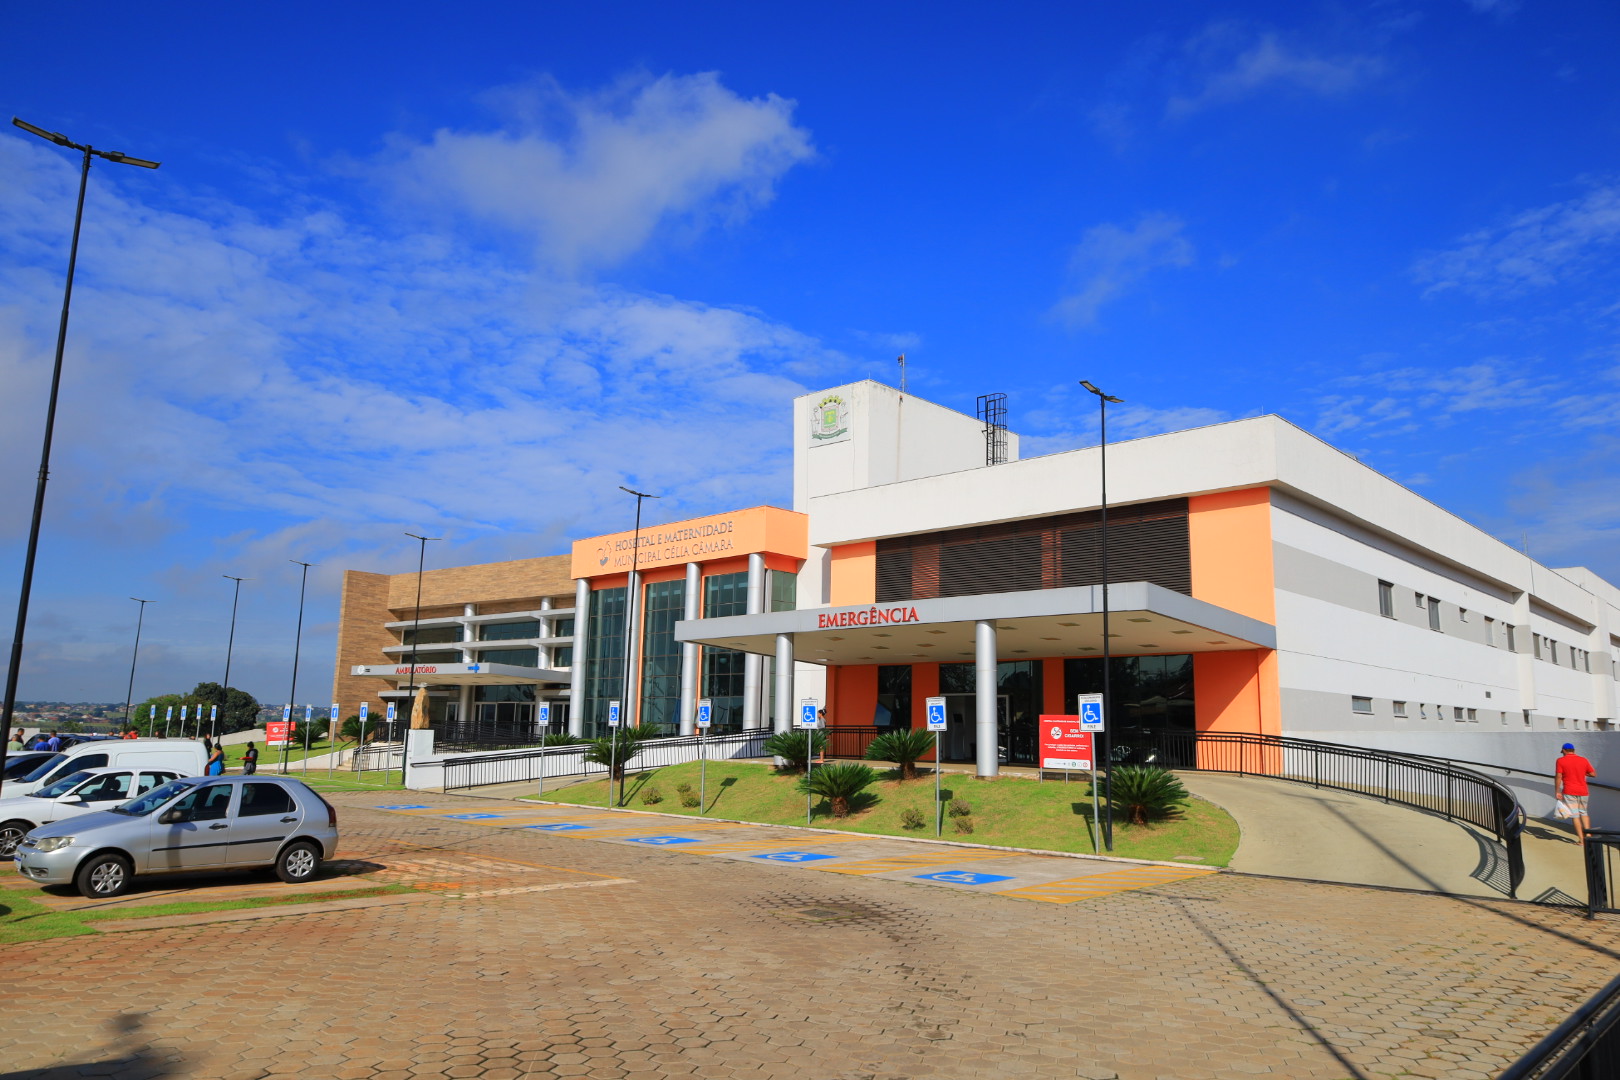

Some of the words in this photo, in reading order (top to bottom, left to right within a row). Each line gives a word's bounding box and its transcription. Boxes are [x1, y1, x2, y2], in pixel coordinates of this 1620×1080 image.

[615, 534, 655, 550] HOSPITAL
[658, 534, 662, 544] E
[664, 521, 733, 542] MATERNIDADE
[614, 551, 661, 567] MUNCIPAL
[692, 539, 733, 555] CÂMARA
[818, 606, 919, 628] EMERGÊNCIA
